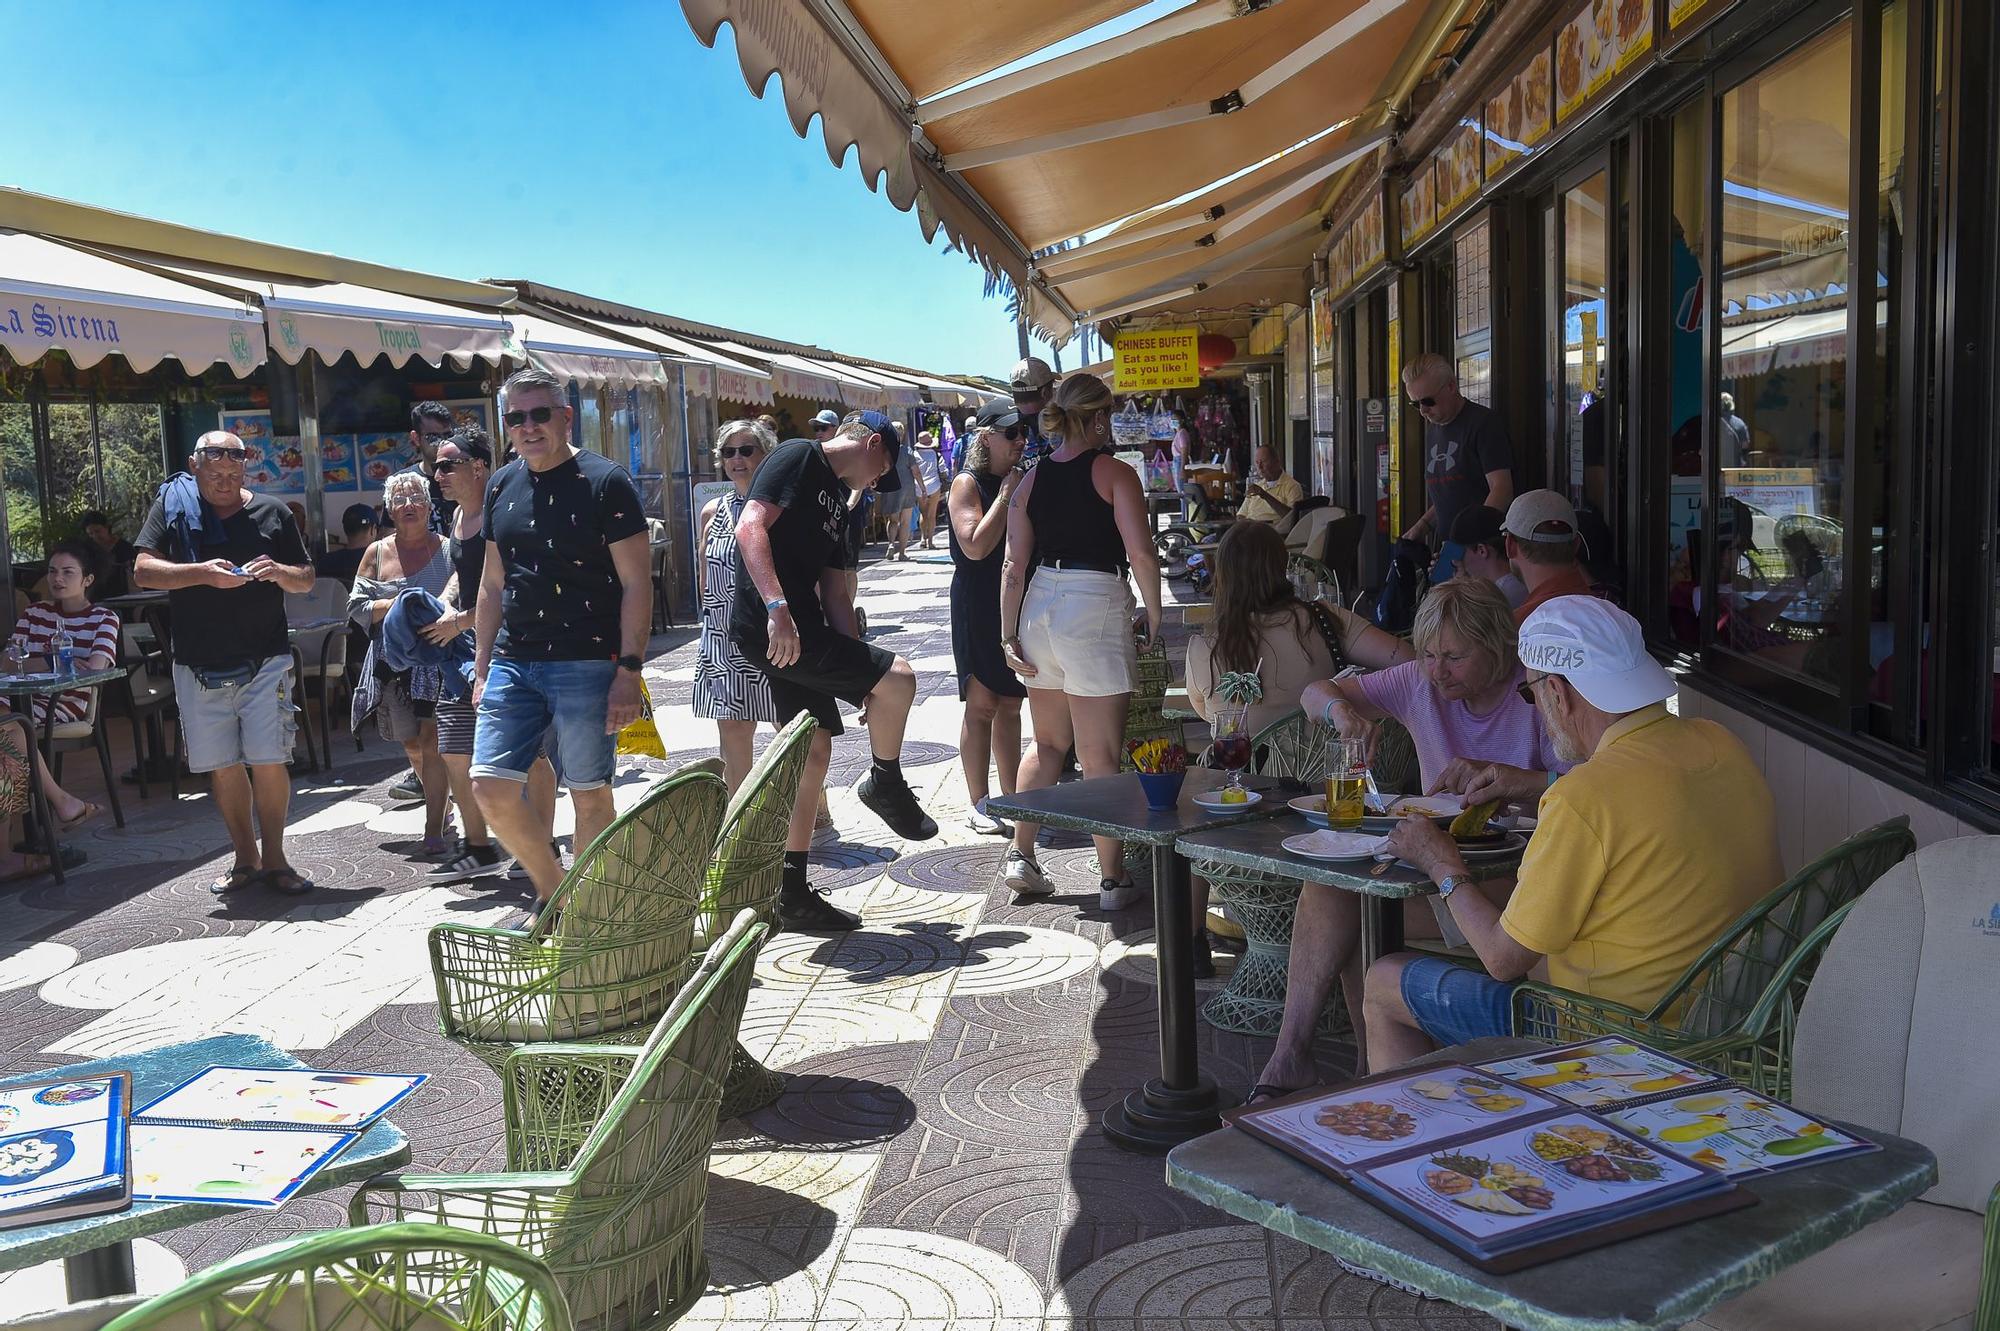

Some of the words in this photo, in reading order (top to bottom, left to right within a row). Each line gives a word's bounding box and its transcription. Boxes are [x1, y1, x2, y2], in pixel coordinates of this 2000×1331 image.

[0, 308, 25, 335] a
[32, 302, 121, 343] Sirena
[375, 321, 422, 354] Tropical
[1117, 338, 1156, 351] CHINESE
[1159, 336, 1193, 349] BUFFET
[1123, 354, 1140, 364] Eat
[1144, 354, 1156, 362] as
[1160, 351, 1188, 361] much
[1124, 367, 1137, 375] as
[1140, 366, 1159, 376] you
[1162, 363, 1181, 373] like
[718, 373, 748, 396] CHINESE
[1119, 379, 1137, 388] Adult
[818, 489, 842, 520] GUE
